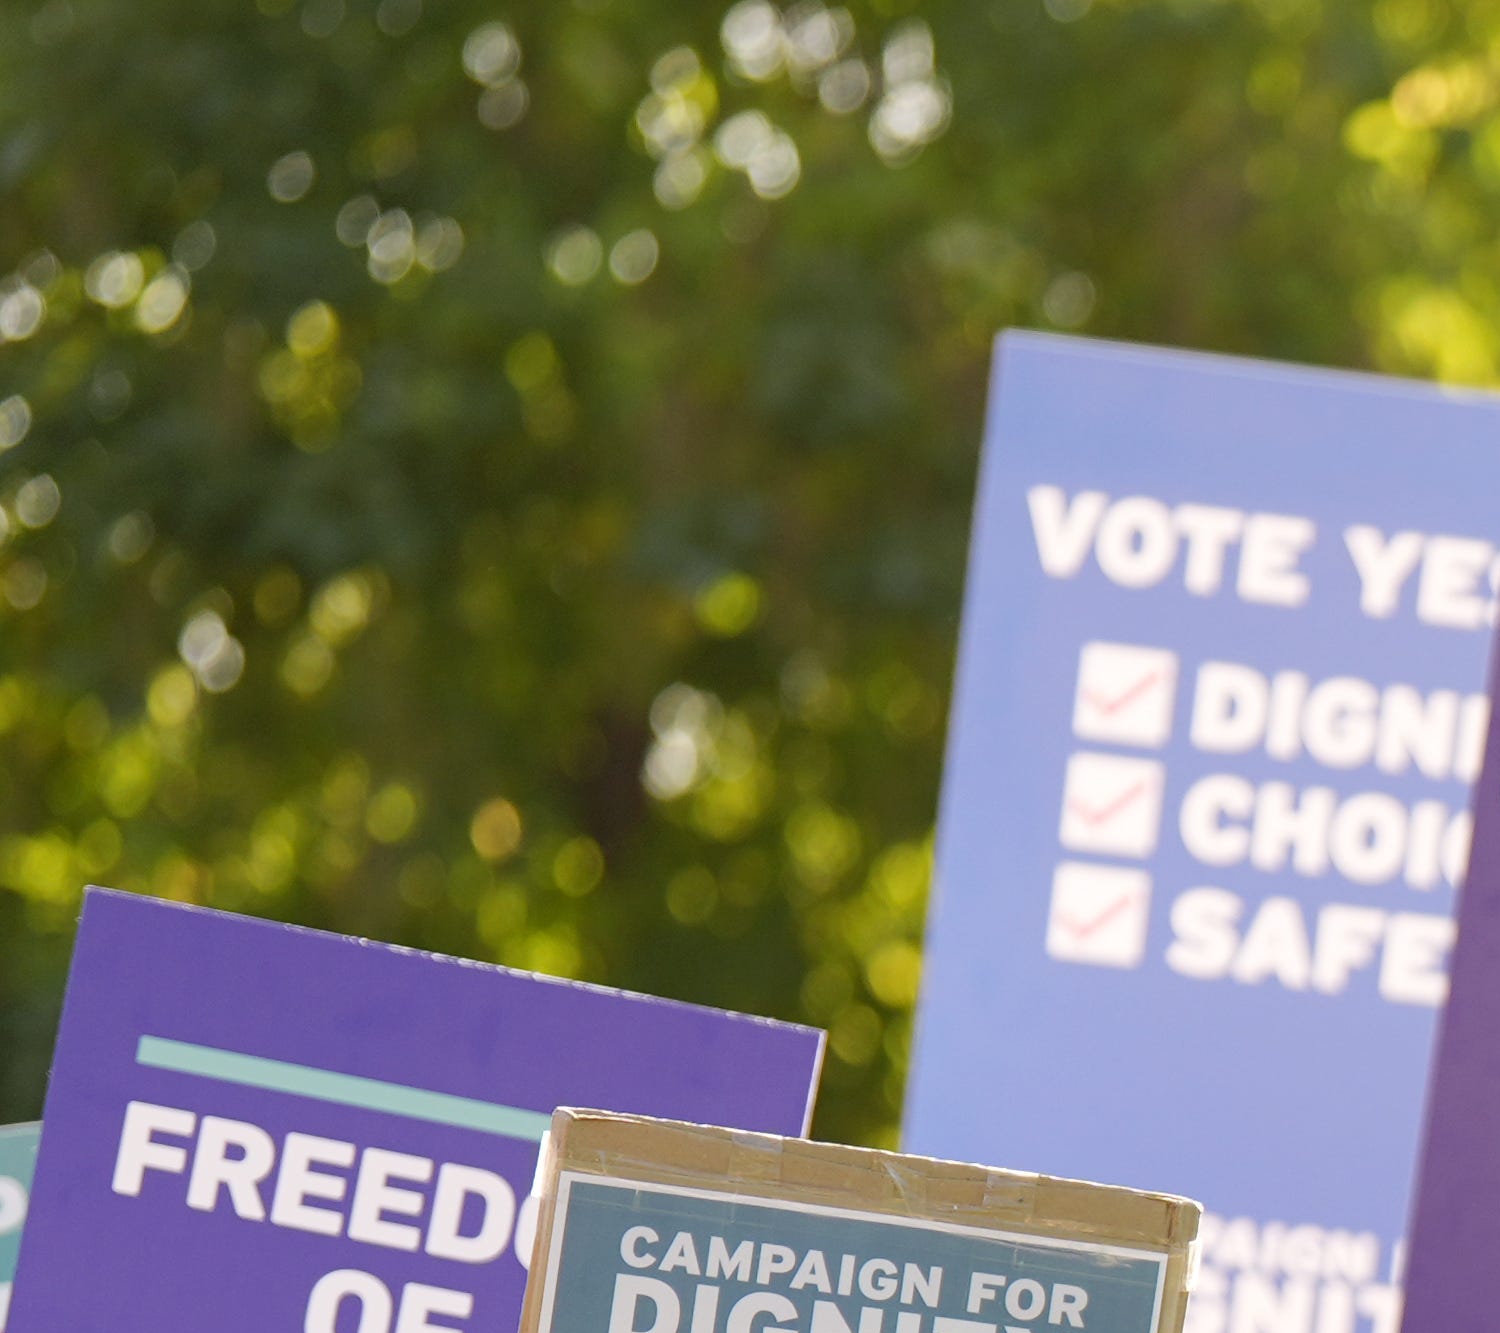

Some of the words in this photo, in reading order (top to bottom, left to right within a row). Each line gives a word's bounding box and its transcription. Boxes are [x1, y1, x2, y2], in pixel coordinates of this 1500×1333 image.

[1026, 484, 1316, 608] VOTE
[619, 1225, 942, 1309] CAMPAIGN
[966, 1272, 1090, 1328] FOR
